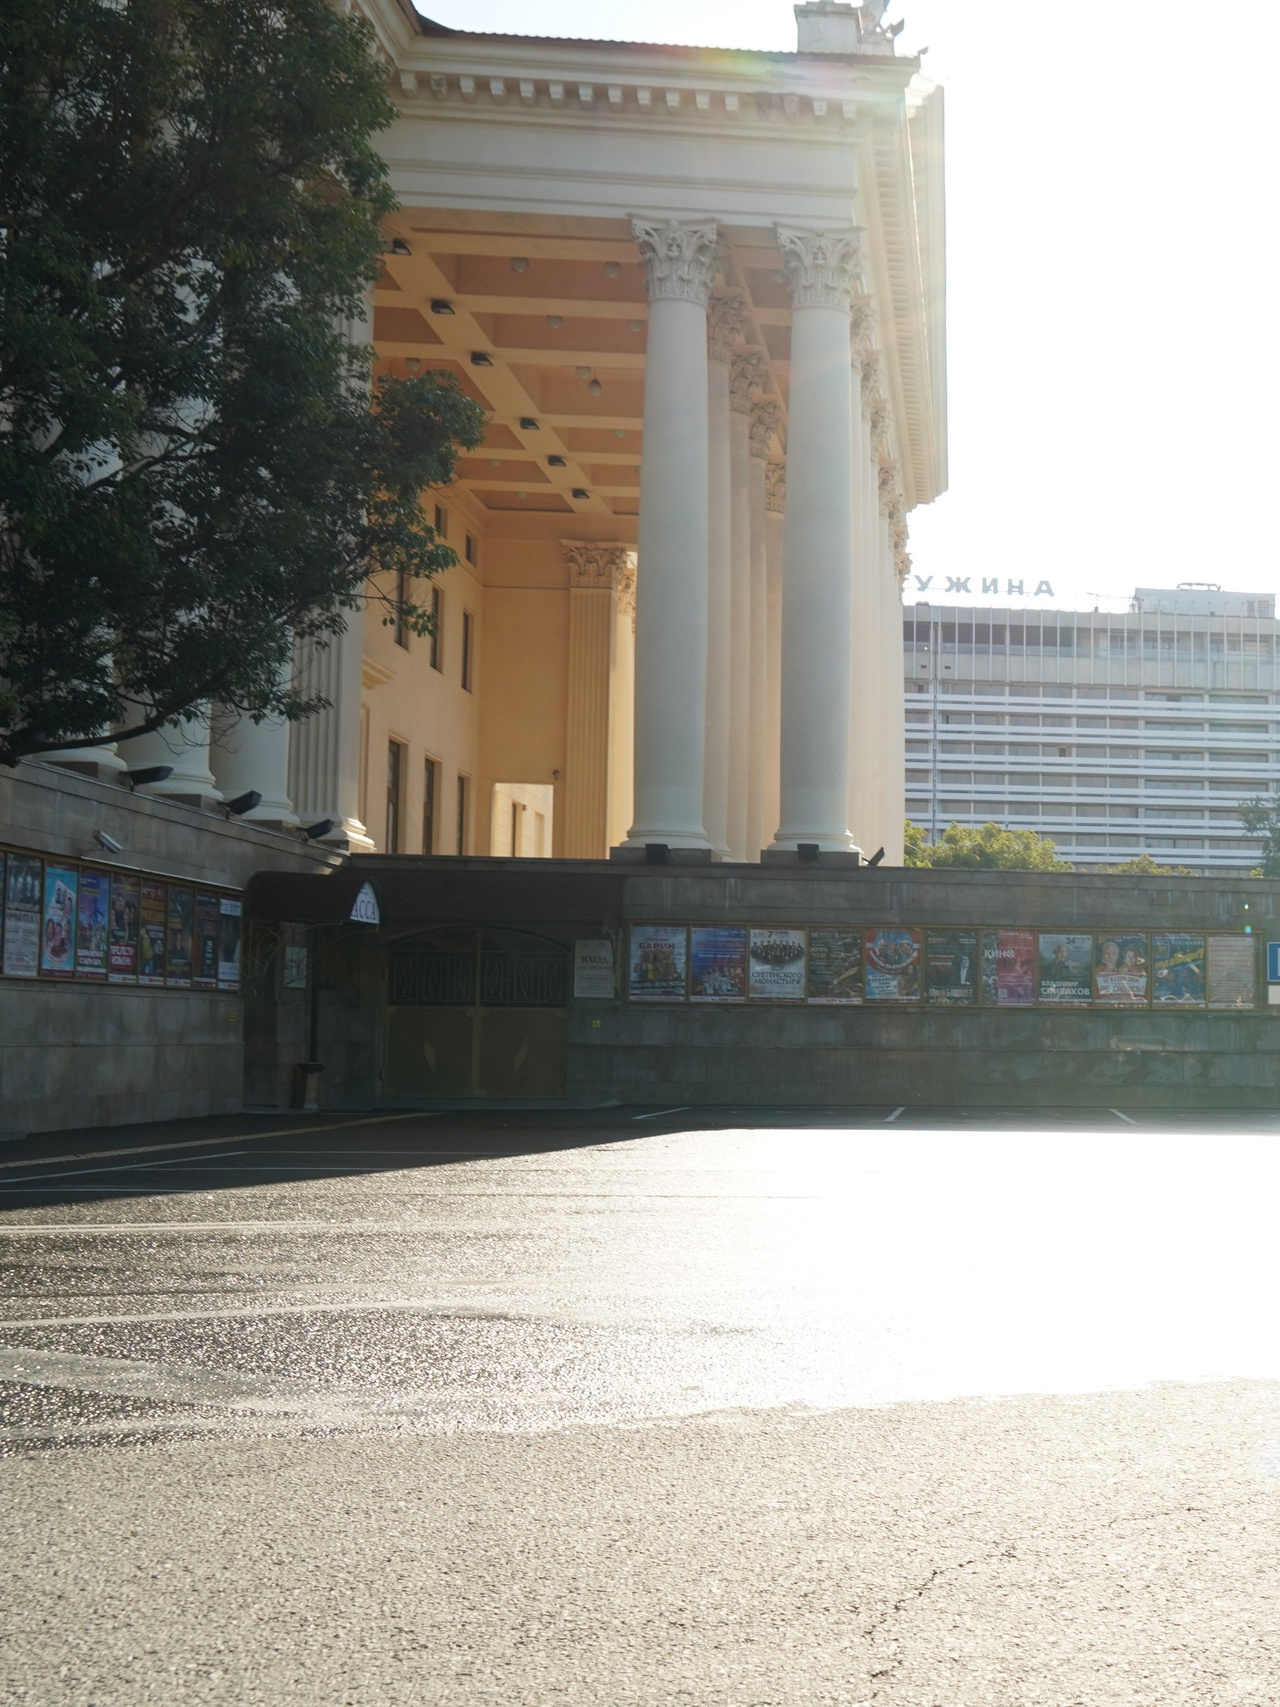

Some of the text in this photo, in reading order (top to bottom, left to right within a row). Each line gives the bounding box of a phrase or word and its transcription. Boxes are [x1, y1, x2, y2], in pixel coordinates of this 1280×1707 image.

[351, 900, 376, 919] АССА
[752, 971, 803, 979] СРЕТЕНСКОГО
[1041, 987, 1090, 995] СПИВАКОВ
